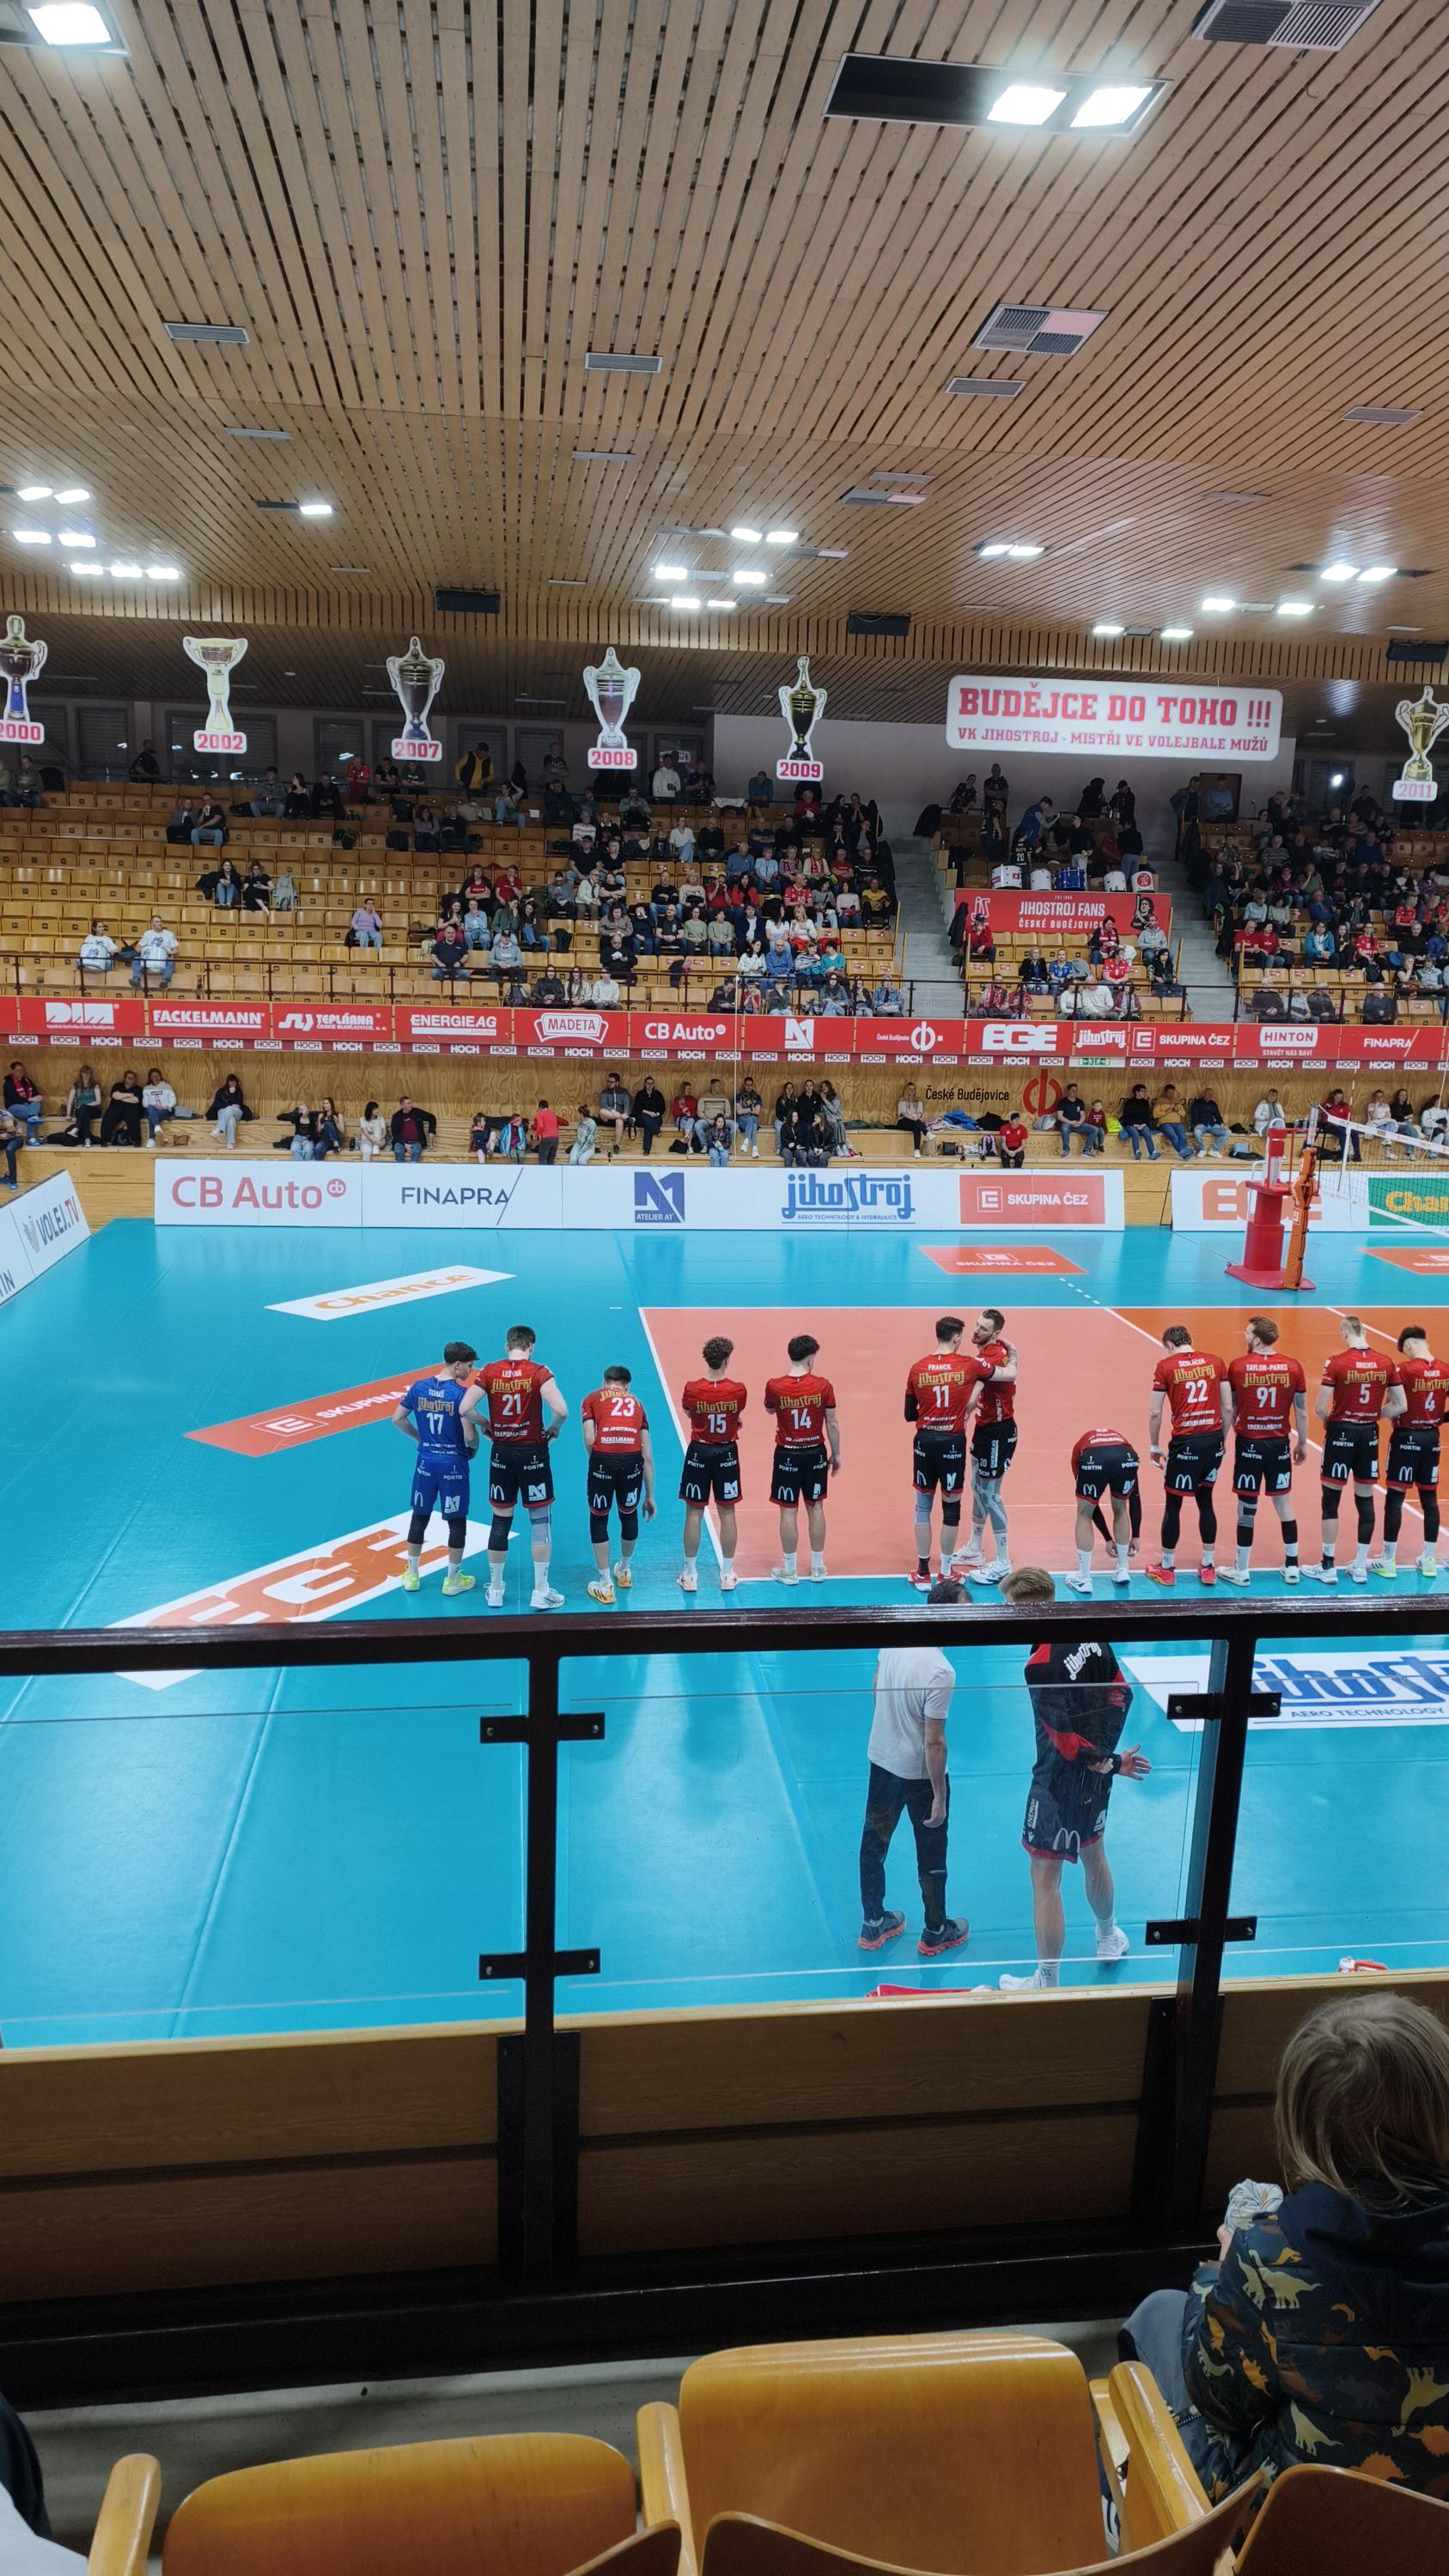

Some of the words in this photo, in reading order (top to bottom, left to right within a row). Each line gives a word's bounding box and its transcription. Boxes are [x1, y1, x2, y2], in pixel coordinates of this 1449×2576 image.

[959, 682, 1098, 721] BUDĚJCE
[1108, 695, 1145, 722] DO
[1157, 696, 1238, 726] TOHO
[0, 723, 41, 742] 2000
[958, 728, 977, 741] VK
[981, 729, 1059, 744] JIHOSTROJ
[1070, 730, 1122, 746] MISTŘI
[1125, 734, 1143, 747] VE
[1147, 735, 1227, 751] VOLEJBALE
[198, 733, 243, 750] 2002
[394, 742, 439, 759] 2007
[592, 750, 633, 766] 2008
[780, 762, 820, 778] 2009
[1398, 783, 1432, 798] 2011
[1020, 902, 1074, 916] JIHOSTROJ
[1078, 902, 1105, 917] FANS
[1019, 918, 1046, 928] ČESKÉ
[153, 1010, 261, 1024] FACKELMANN
[548, 1018, 595, 1031] MADETA
[645, 1023, 669, 1040] CB
[673, 1023, 715, 1041] Auto
[983, 1024, 1058, 1052] EGE
[1160, 1035, 1206, 1045] SKUPINA
[1209, 1033, 1230, 1046] ČEZ
[1264, 1032, 1314, 1042] HINTON
[91, 1037, 122, 1046] HOCH
[213, 1040, 243, 1048] HOCH
[333, 1042, 362, 1051] HOCH
[451, 1045, 479, 1054] HOCH
[1364, 1037, 1412, 1048] FINAPRA
[565, 1048, 593, 1057] HOCH
[678, 1050, 705, 1059] HOCH
[788, 1053, 815, 1061] HOCH
[896, 1054, 922, 1063] HOCH
[1003, 1057, 1030, 1066] HOCH
[1164, 1059, 1190, 1067] HOCH
[1267, 1060, 1294, 1068] HOCH
[925, 1084, 954, 1101] České
[958, 1085, 1010, 1103] Budějovice
[172, 1176, 224, 1208] CB
[232, 1176, 323, 1210] Auto
[401, 1186, 510, 1206] FINAPRA
[782, 1173, 916, 1220] jihostroj
[1008, 1194, 1061, 1206] SKUPINA
[1063, 1192, 1088, 1206] ČEZ
[36, 1196, 79, 1245] VOLEJ.TV
[314, 1273, 476, 1310] Chance
[933, 1385, 949, 1408] 11
[1185, 1379, 1209, 1404] 22
[1257, 1387, 1276, 1408] 91
[1359, 1383, 1371, 1404] 5
[316, 1390, 406, 1419] SKUPINA
[502, 1394, 521, 1416] 21
[611, 1397, 635, 1417] 23
[1425, 1392, 1435, 1412] 4
[427, 1413, 444, 1435] 17
[708, 1413, 727, 1434] 15
[791, 1408, 812, 1430] 14
[1336, 1706, 1445, 1716] TECHNOLOGY
